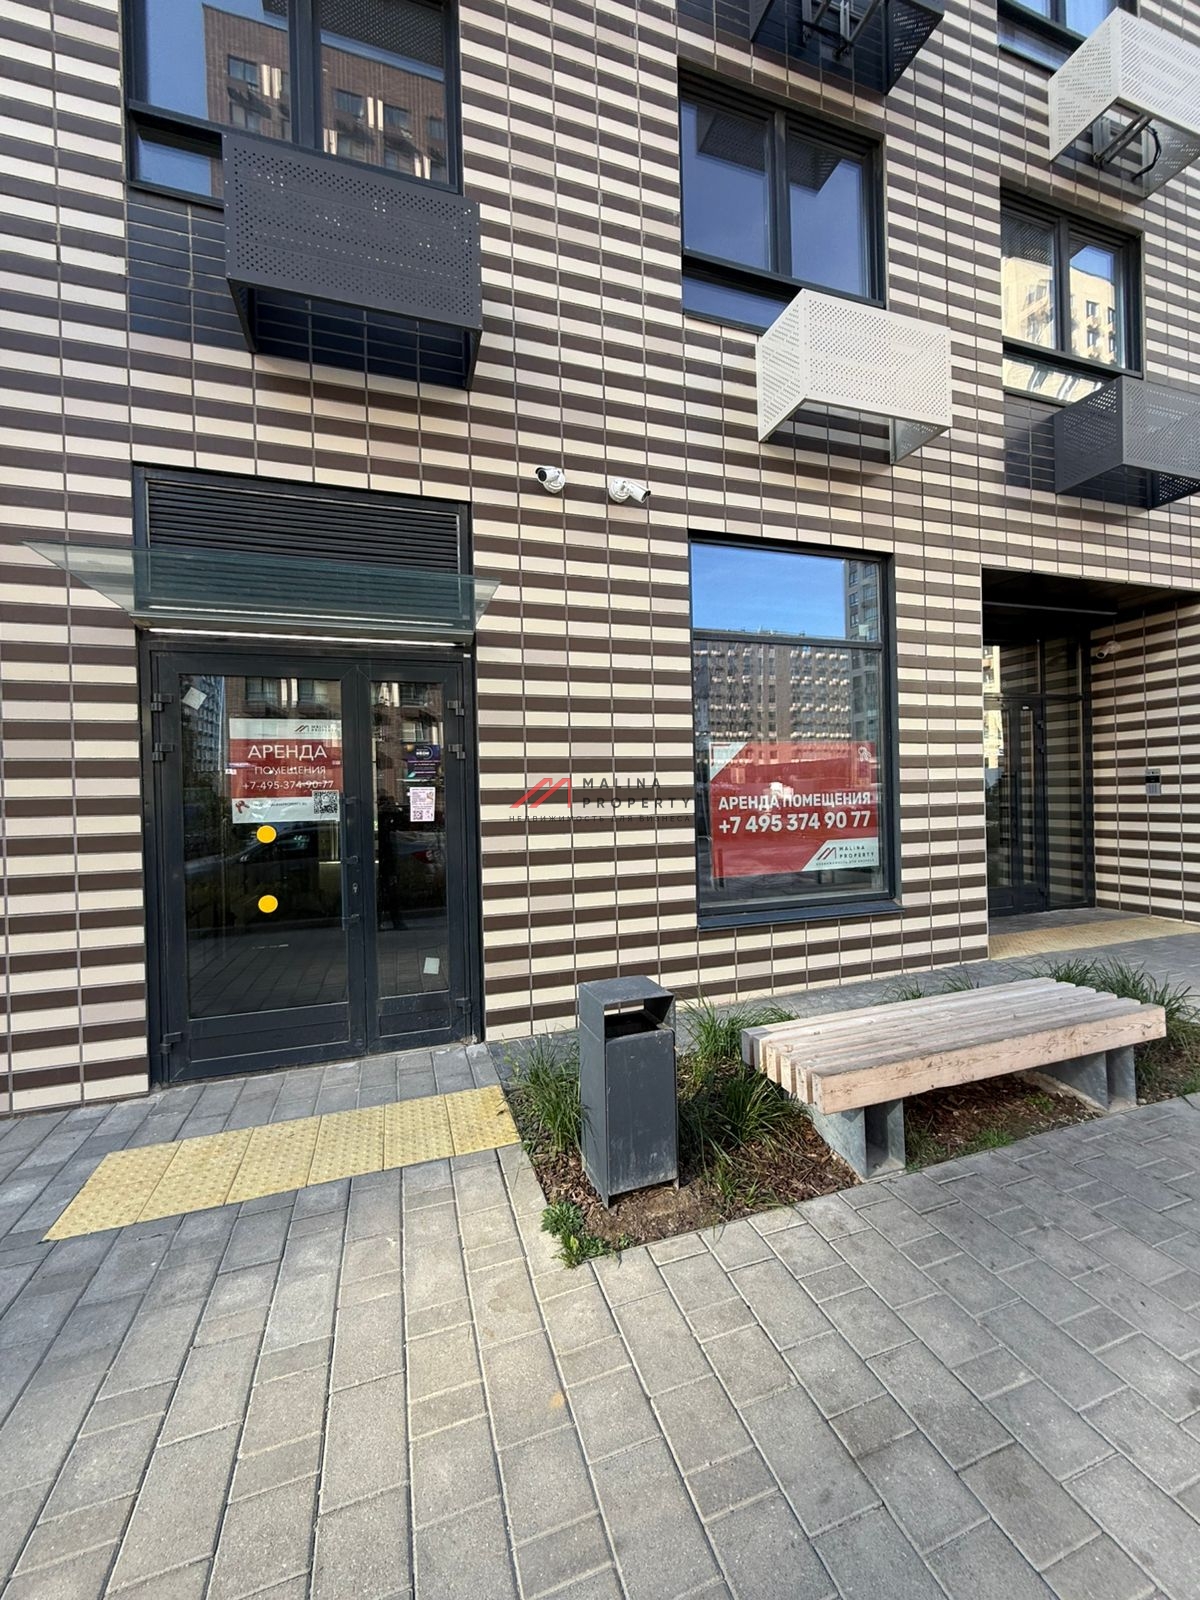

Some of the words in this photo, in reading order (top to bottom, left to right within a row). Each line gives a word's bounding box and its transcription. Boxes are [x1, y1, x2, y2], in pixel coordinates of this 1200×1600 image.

[248, 744, 327, 761] АРЕНДА
[254, 765, 326, 776] ПОМЕЩЕНИЯ
[718, 796, 780, 811] АРЕНДА
[782, 791, 871, 808] ПОМЕЩЕНИЯ
[718, 816, 741, 834] +7
[745, 814, 782, 833] 495
[786, 812, 820, 831] 374
[824, 811, 847, 829] 90
[851, 810, 871, 828] 77
